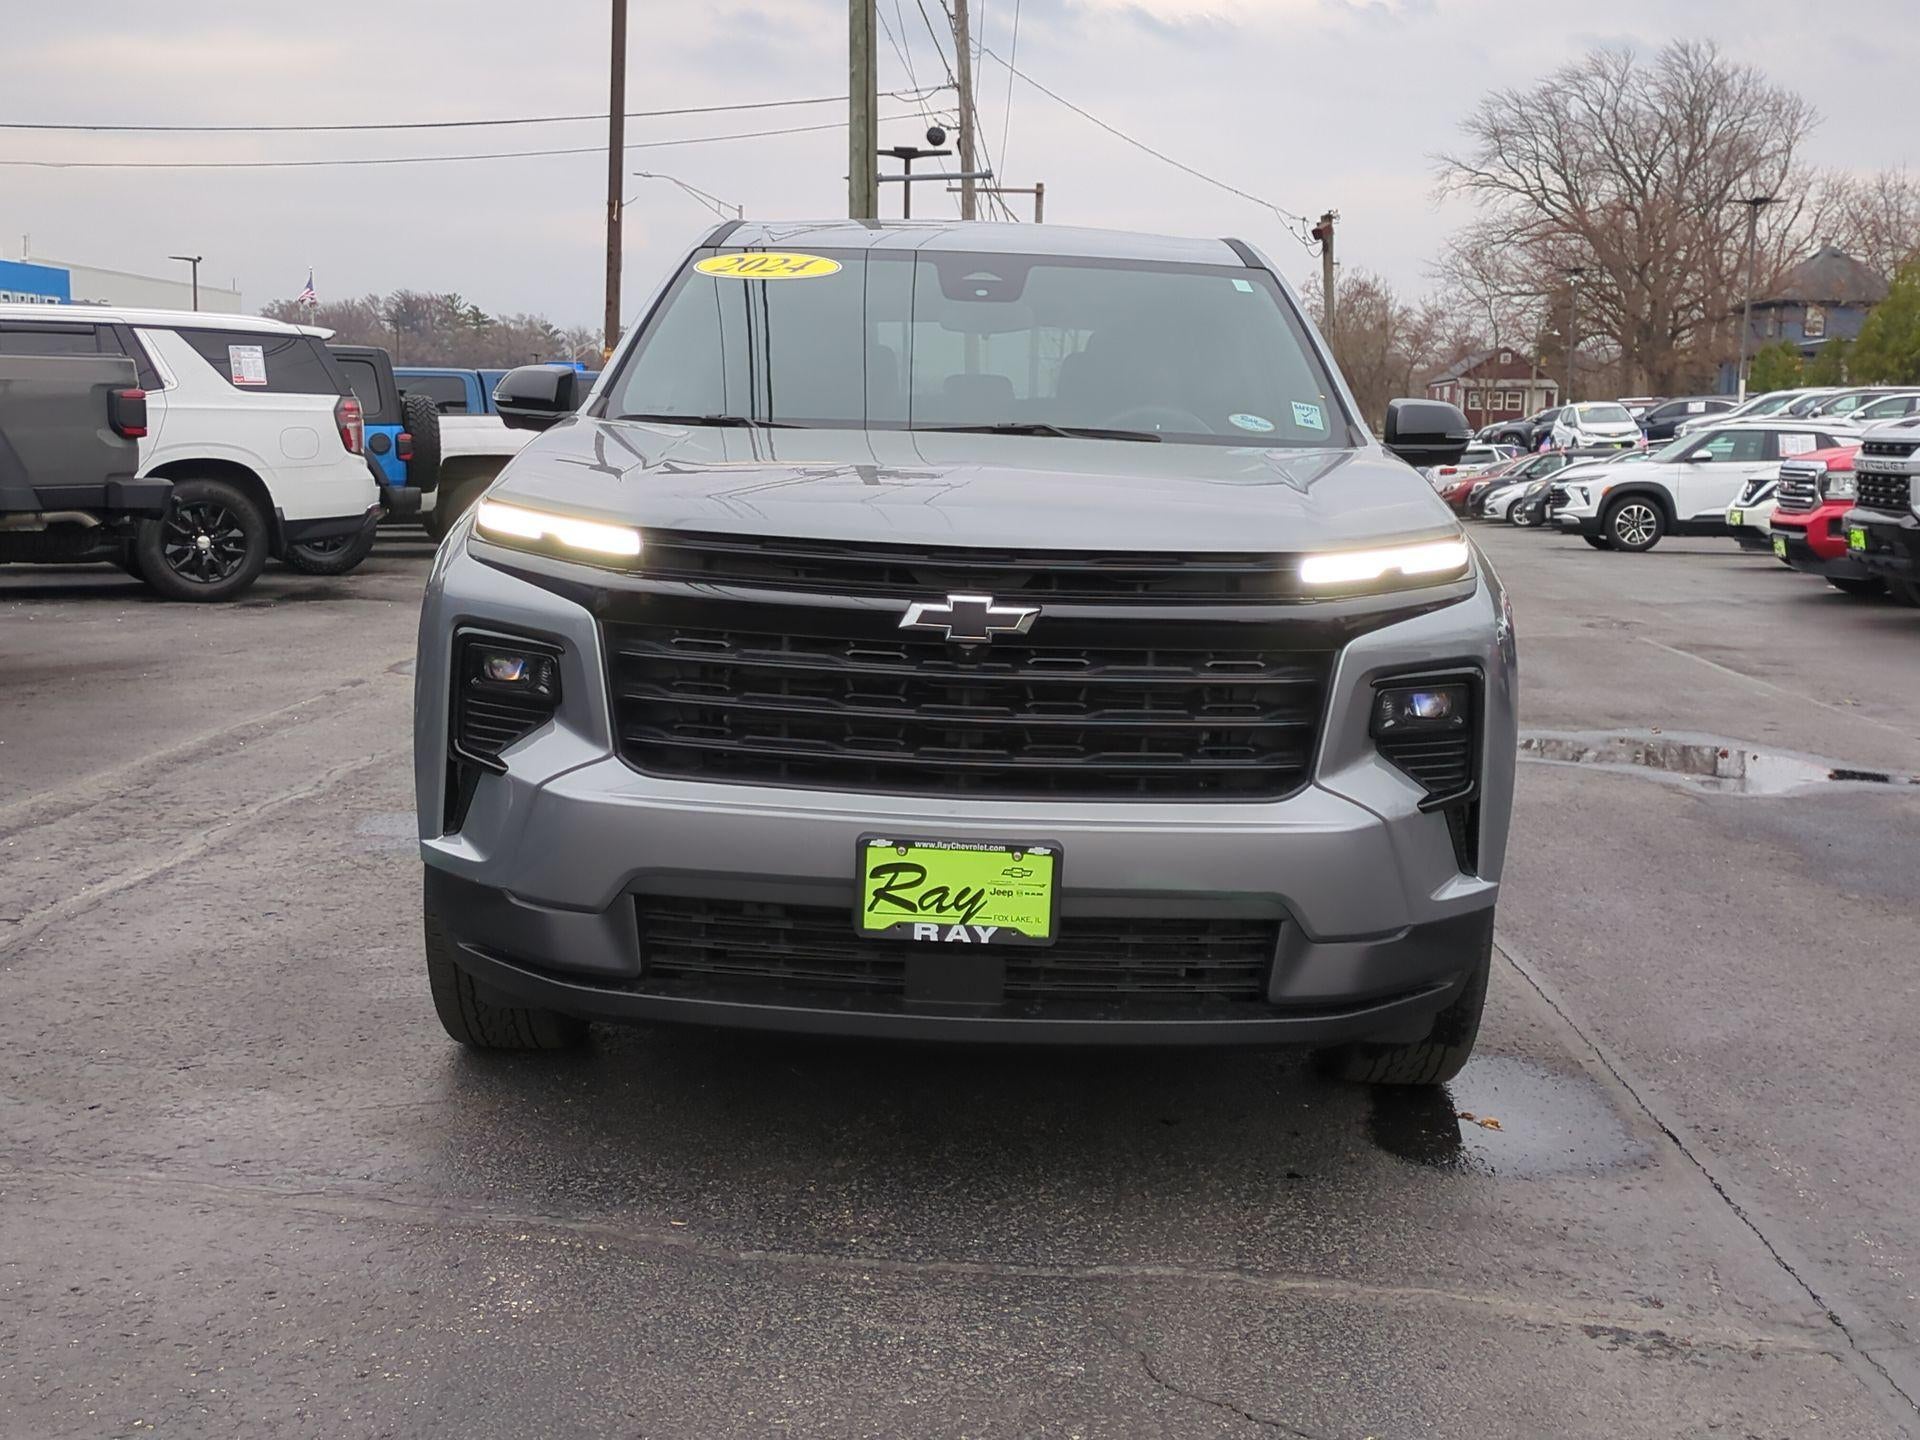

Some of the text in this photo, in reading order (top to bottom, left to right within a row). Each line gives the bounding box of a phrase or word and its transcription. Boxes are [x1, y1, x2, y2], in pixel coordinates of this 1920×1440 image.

[711, 257, 818, 273] 2024
[914, 840, 1006, 853] www.RayChevrolet.com
[867, 862, 988, 925] Ray
[989, 887, 1014, 898] Jeep
[993, 914, 1009, 922] FOX
[1010, 916, 1033, 924] LAKE,
[914, 922, 999, 944] RAY
